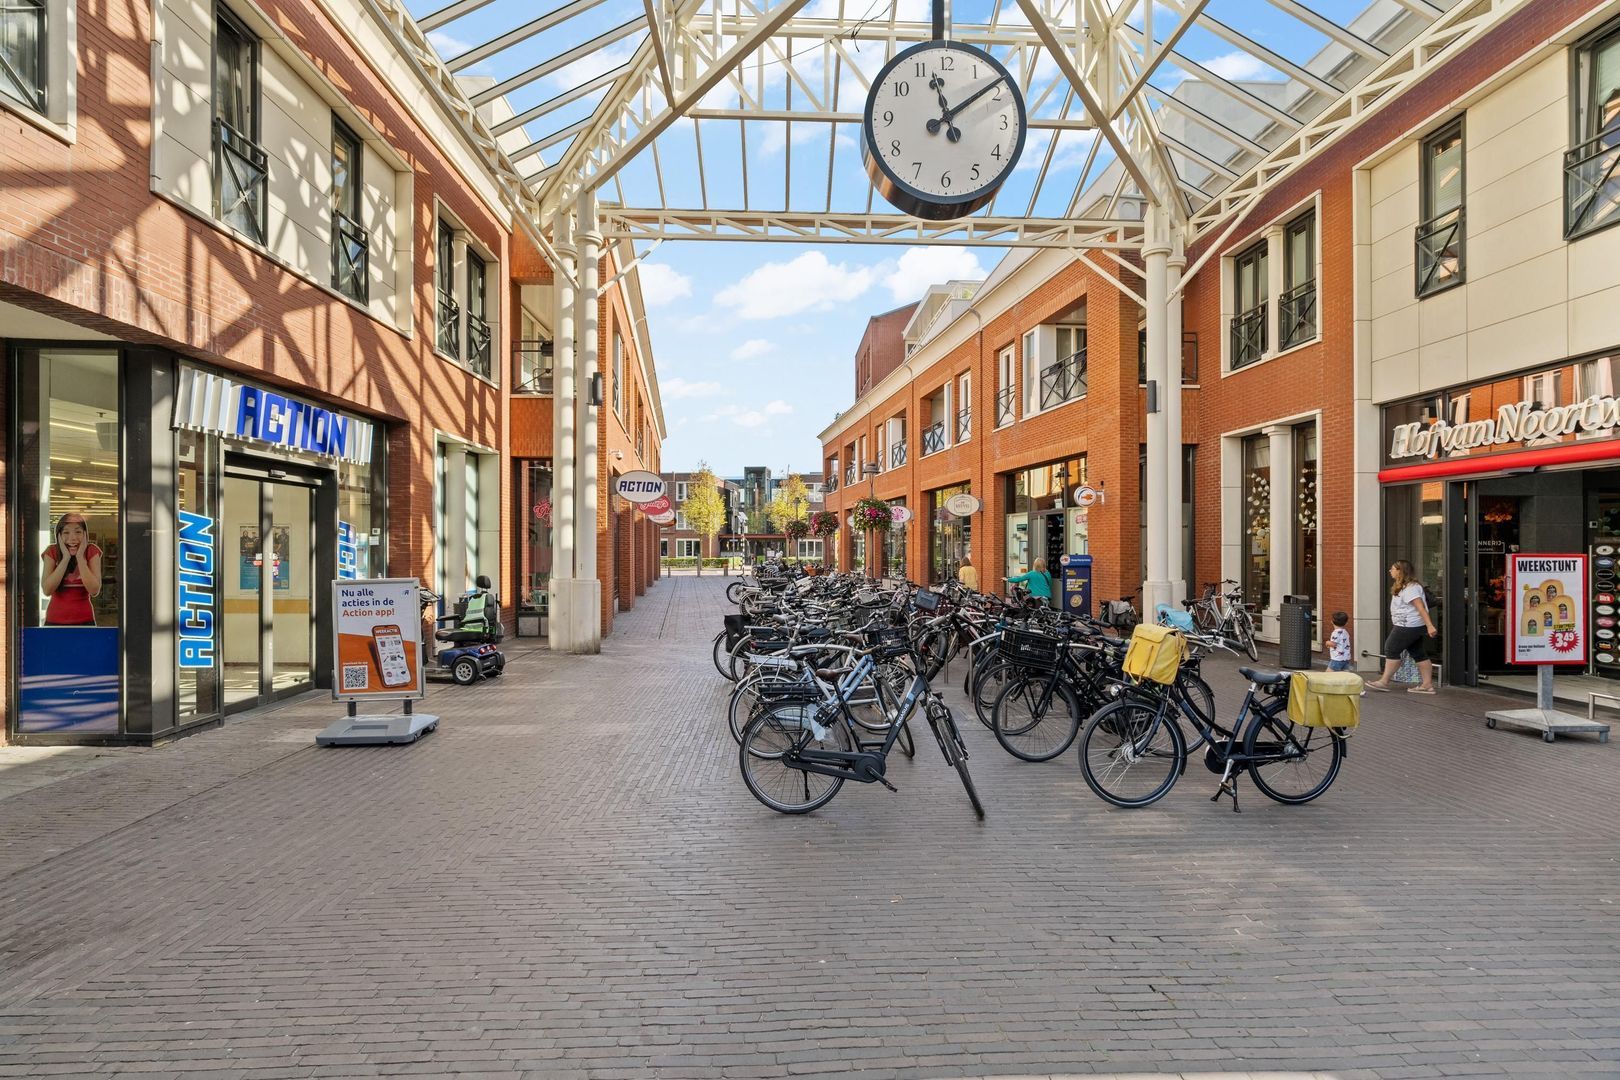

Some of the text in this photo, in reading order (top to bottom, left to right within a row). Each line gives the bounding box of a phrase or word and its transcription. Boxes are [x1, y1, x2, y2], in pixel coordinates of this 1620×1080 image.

[914, 62, 927, 77] 11
[940, 56, 954, 71] 12
[972, 64, 978, 79] 1
[893, 81, 909, 97] 10
[991, 85, 1001, 101] 2
[883, 111, 894, 127] 9
[999, 114, 1008, 130] 3
[891, 140, 901, 157] 8
[990, 143, 1001, 160] 4
[912, 162, 922, 179] 7
[970, 163, 980, 180] 5
[940, 170, 951, 188] 6
[236, 385, 348, 457] ACTION
[619, 480, 662, 493] ACTION
[1517, 559, 1578, 572] WEEKSTUNT
[179, 510, 214, 668] ACTION
[341, 588, 374, 597] Nu alle
[341, 598, 394, 607] acties in de
[342, 608, 395, 617] Action app!
[1554, 632, 1575, 648] 3.49
[895, 703, 910, 727] PEGASUS
